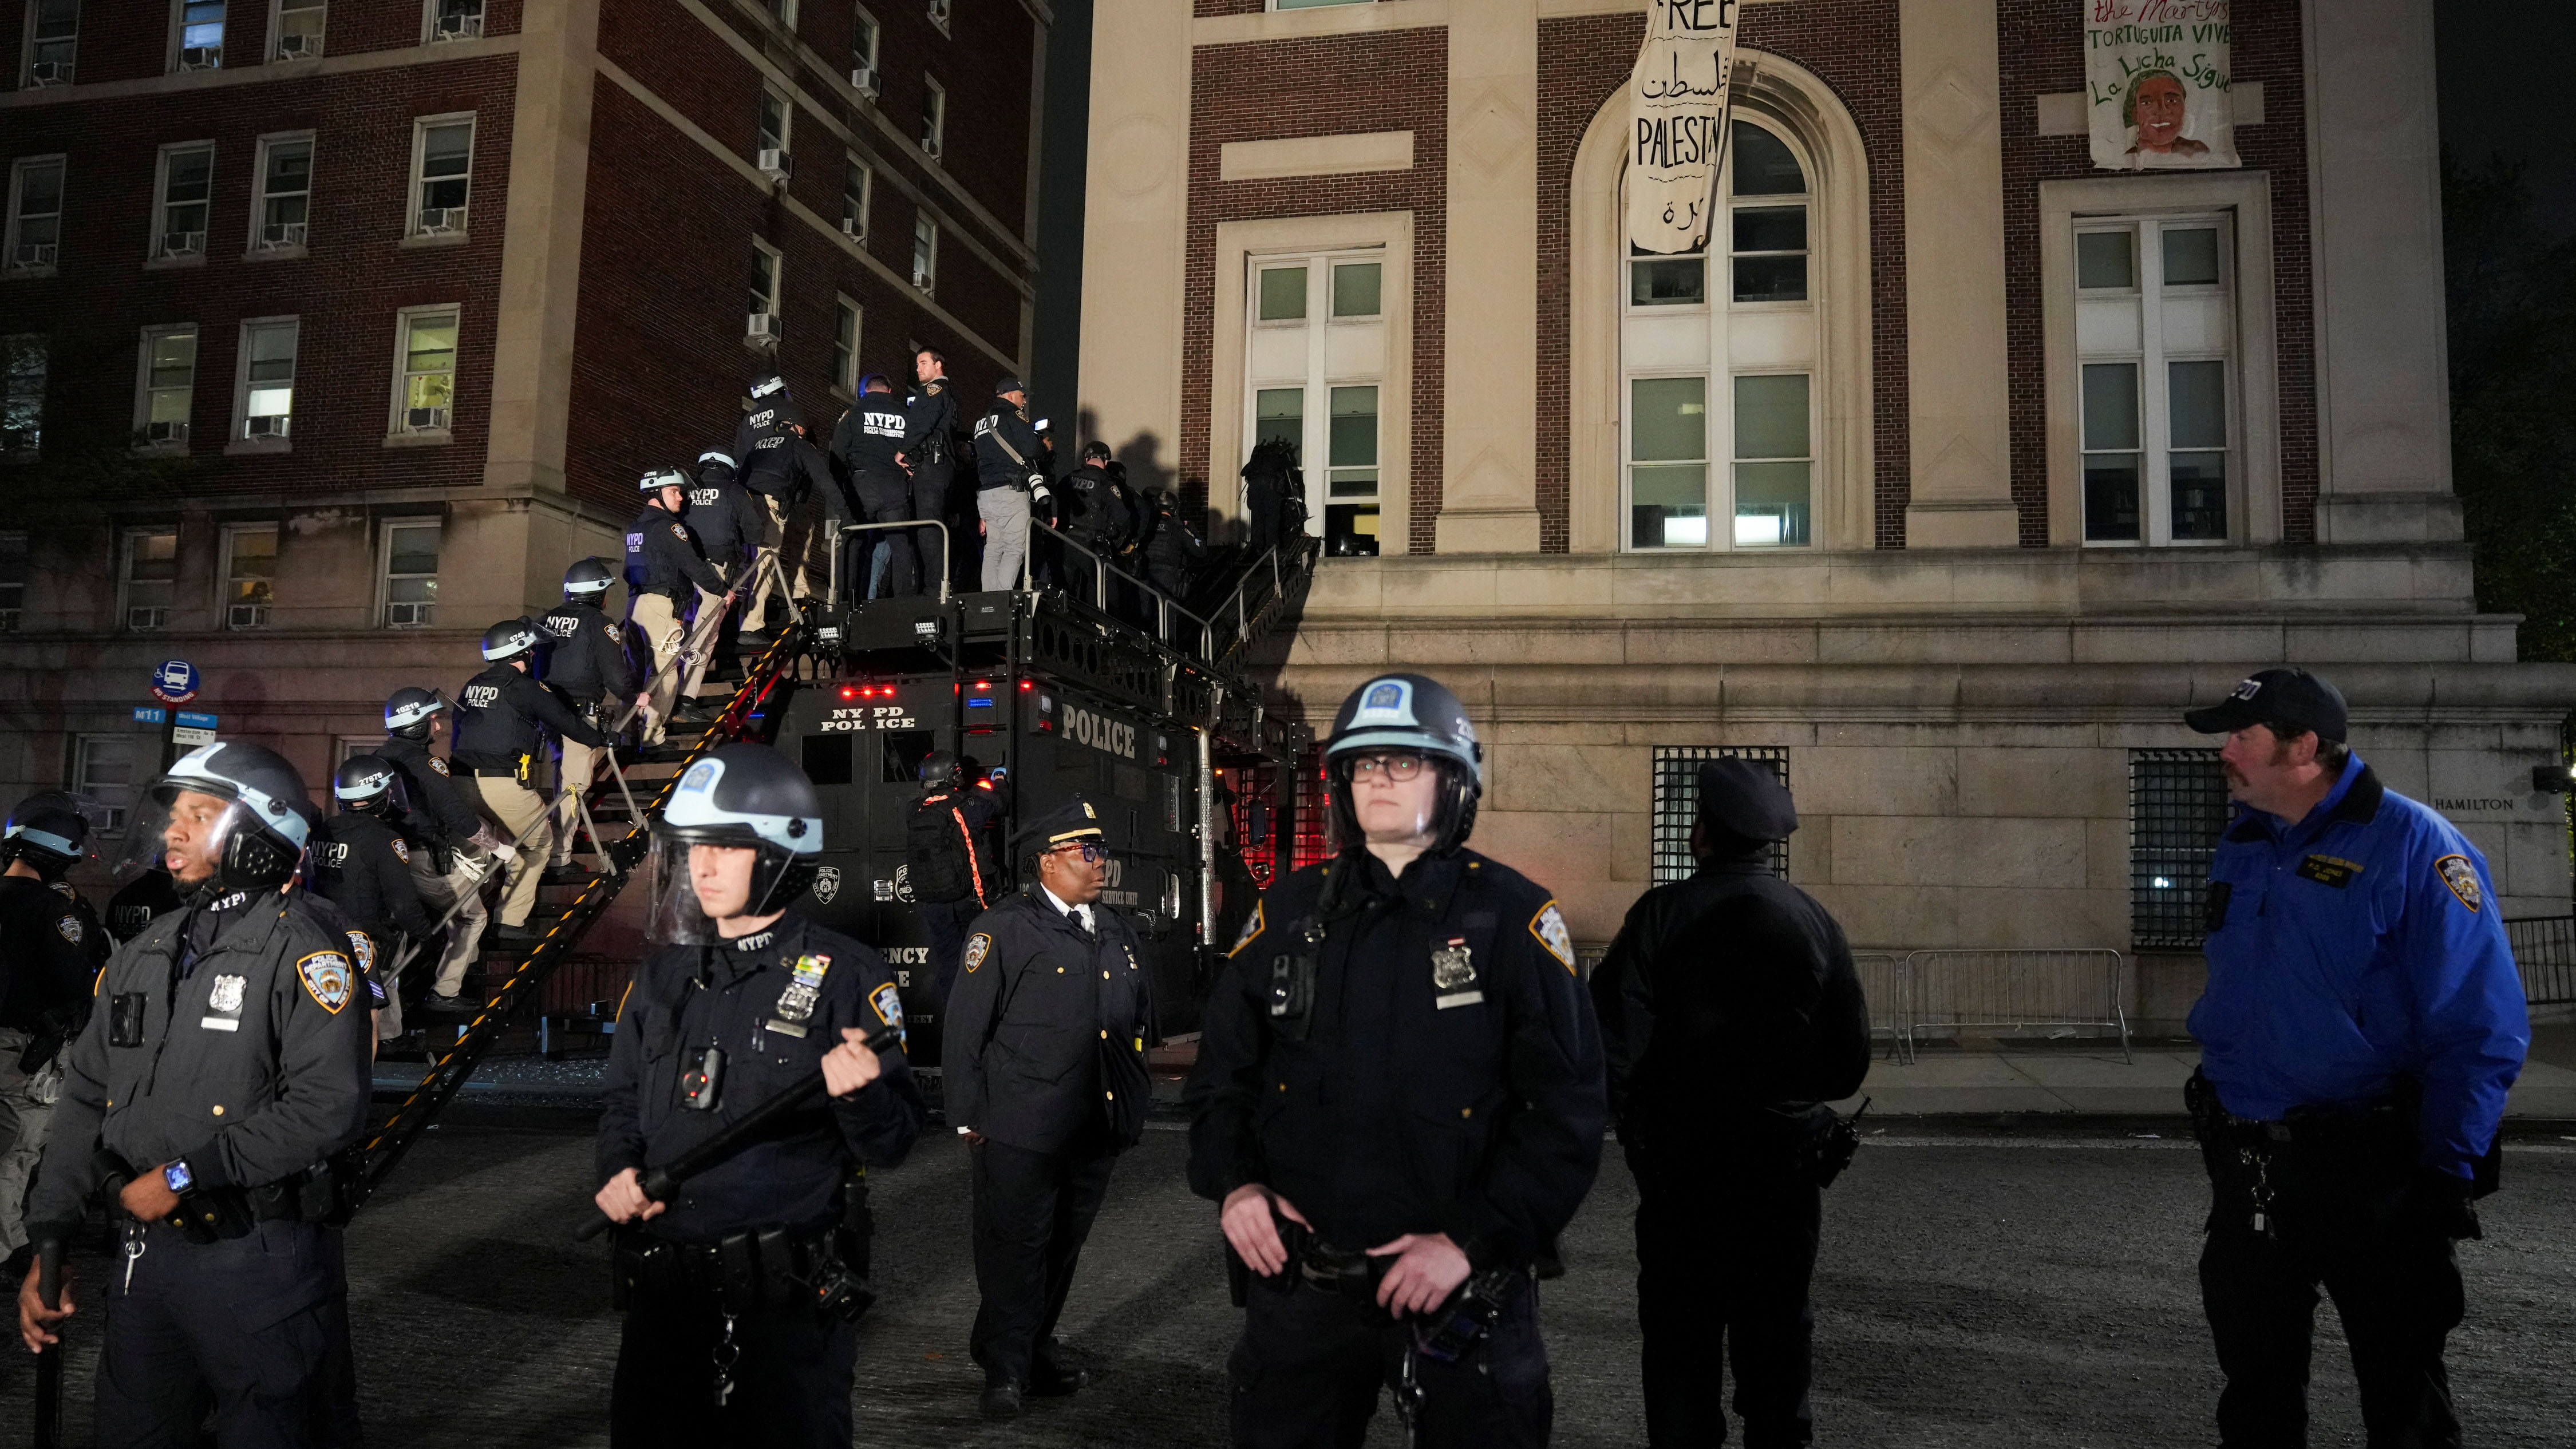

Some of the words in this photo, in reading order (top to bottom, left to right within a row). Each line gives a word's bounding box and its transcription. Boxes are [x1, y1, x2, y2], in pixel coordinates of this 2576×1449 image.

[1657, 0, 1735, 30] REE
[2094, 0, 2132, 22] the
[2138, 0, 2228, 22] Martyrs
[2088, 25, 2183, 49] TORTUGUITA
[2192, 23, 2230, 44] VIVE
[2091, 81, 2121, 106] La
[2182, 53, 2231, 93] Sigue
[749, 409, 774, 425] NYPD
[864, 412, 906, 430] NYPD
[753, 419, 770, 430] POLICE
[754, 437, 784, 447] NYPD
[689, 488, 719, 500] NYPD
[626, 533, 643, 545] NYPD
[545, 616, 579, 630] NYPD
[509, 631, 525, 642] 6749
[153, 688, 163, 696] NO
[162, 691, 195, 703] STANDING
[465, 686, 499, 700] NYPD
[396, 702, 420, 714] 10219
[467, 699, 489, 708] POLICE
[135, 710, 160, 721] M11
[832, 708, 863, 719] NY
[874, 707, 903, 717] PD
[821, 720, 866, 731] POL
[876, 718, 915, 729] ICE
[1062, 703, 1135, 759] POLICE
[2435, 799, 2513, 810] HAMILTON
[311, 841, 348, 860] NYPD
[313, 857, 342, 868] POLICE
[1101, 890, 1124, 905] SERVICE
[1125, 891, 1138, 905] UNIT
[311, 954, 338, 964] POLICE
[304, 961, 347, 975] DEPARTMENT
[307, 979, 321, 995] CITY
